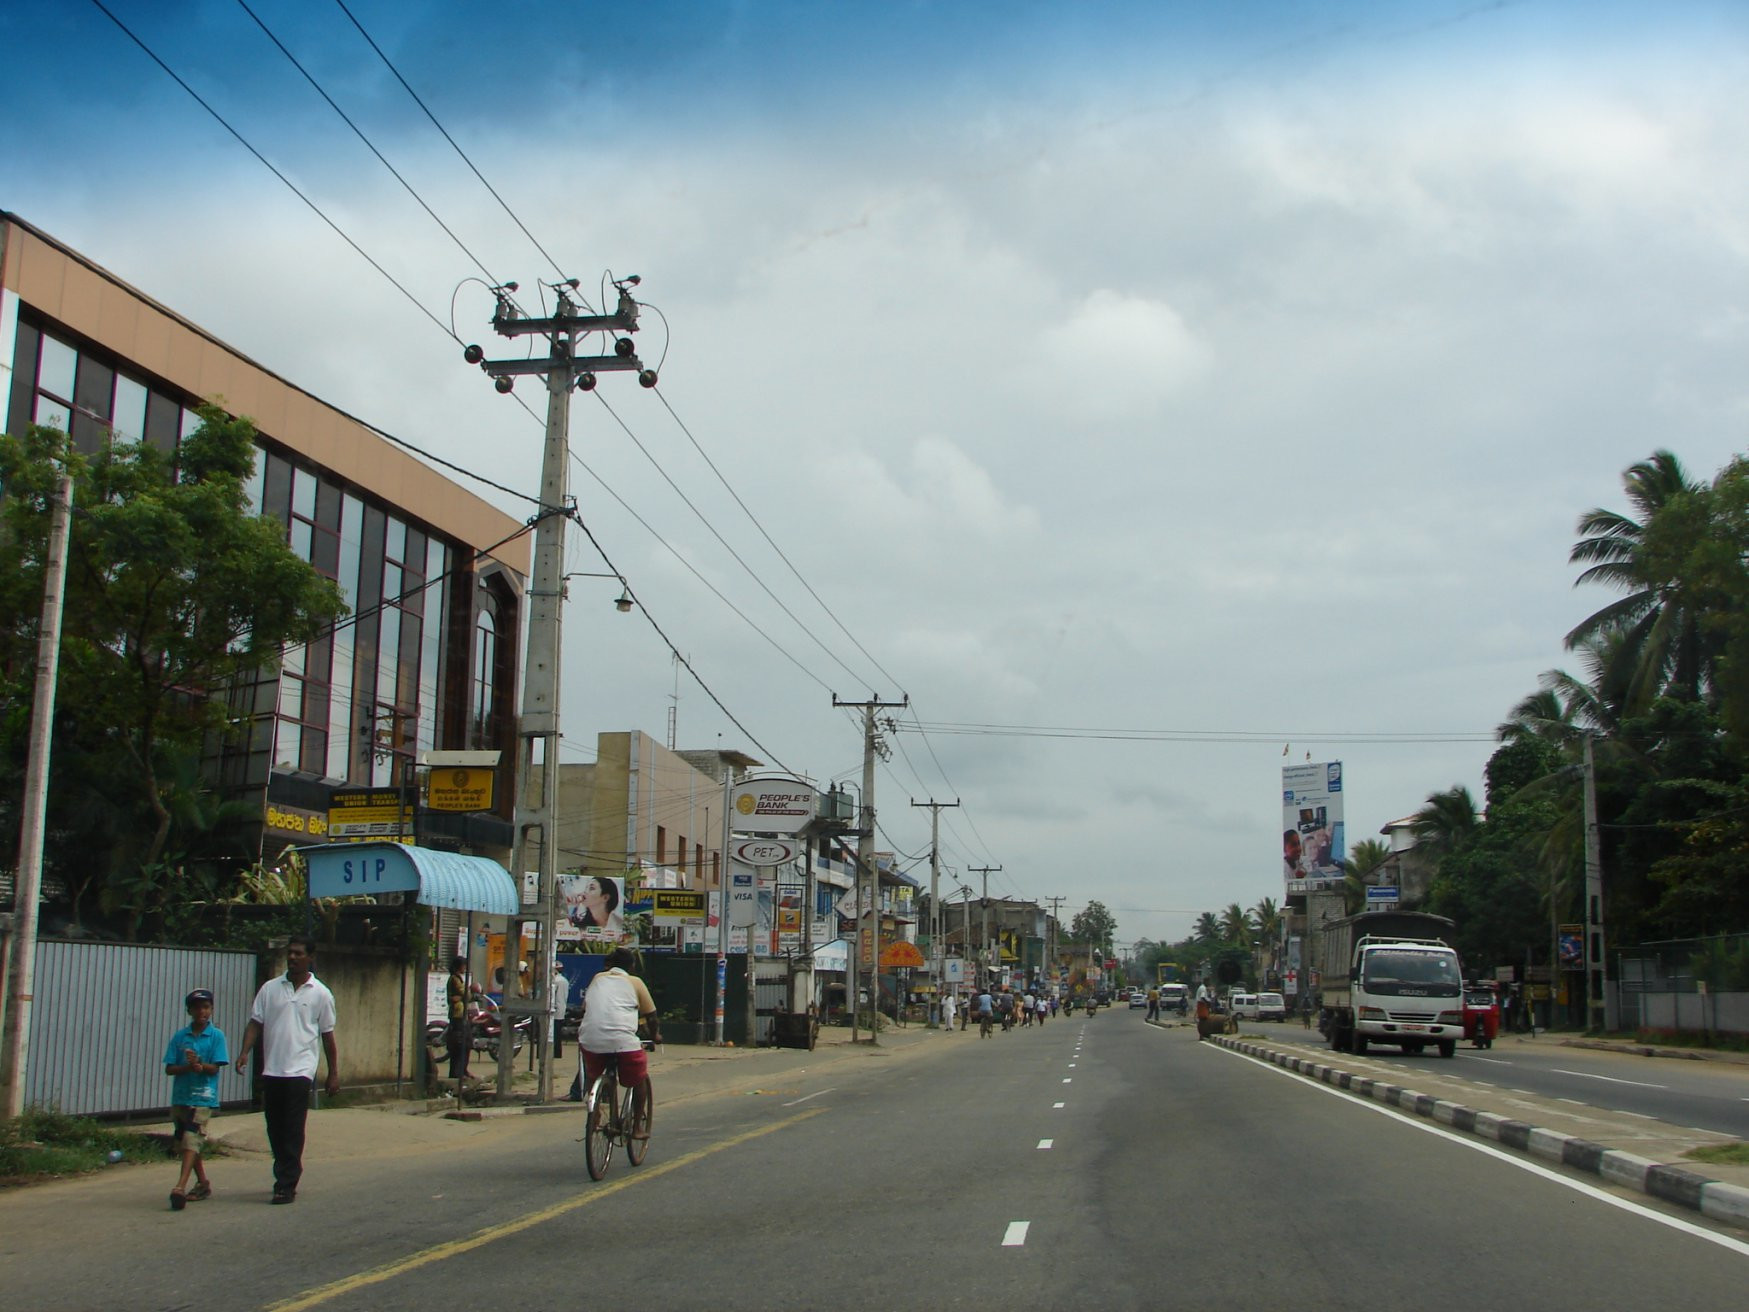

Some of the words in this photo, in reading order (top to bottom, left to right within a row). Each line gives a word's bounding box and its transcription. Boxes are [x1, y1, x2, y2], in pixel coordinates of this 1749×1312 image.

[759, 794, 811, 802] PEOPLE'S
[757, 801, 789, 809] BANK
[753, 847, 775, 858] PET
[344, 858, 386, 884] SIP
